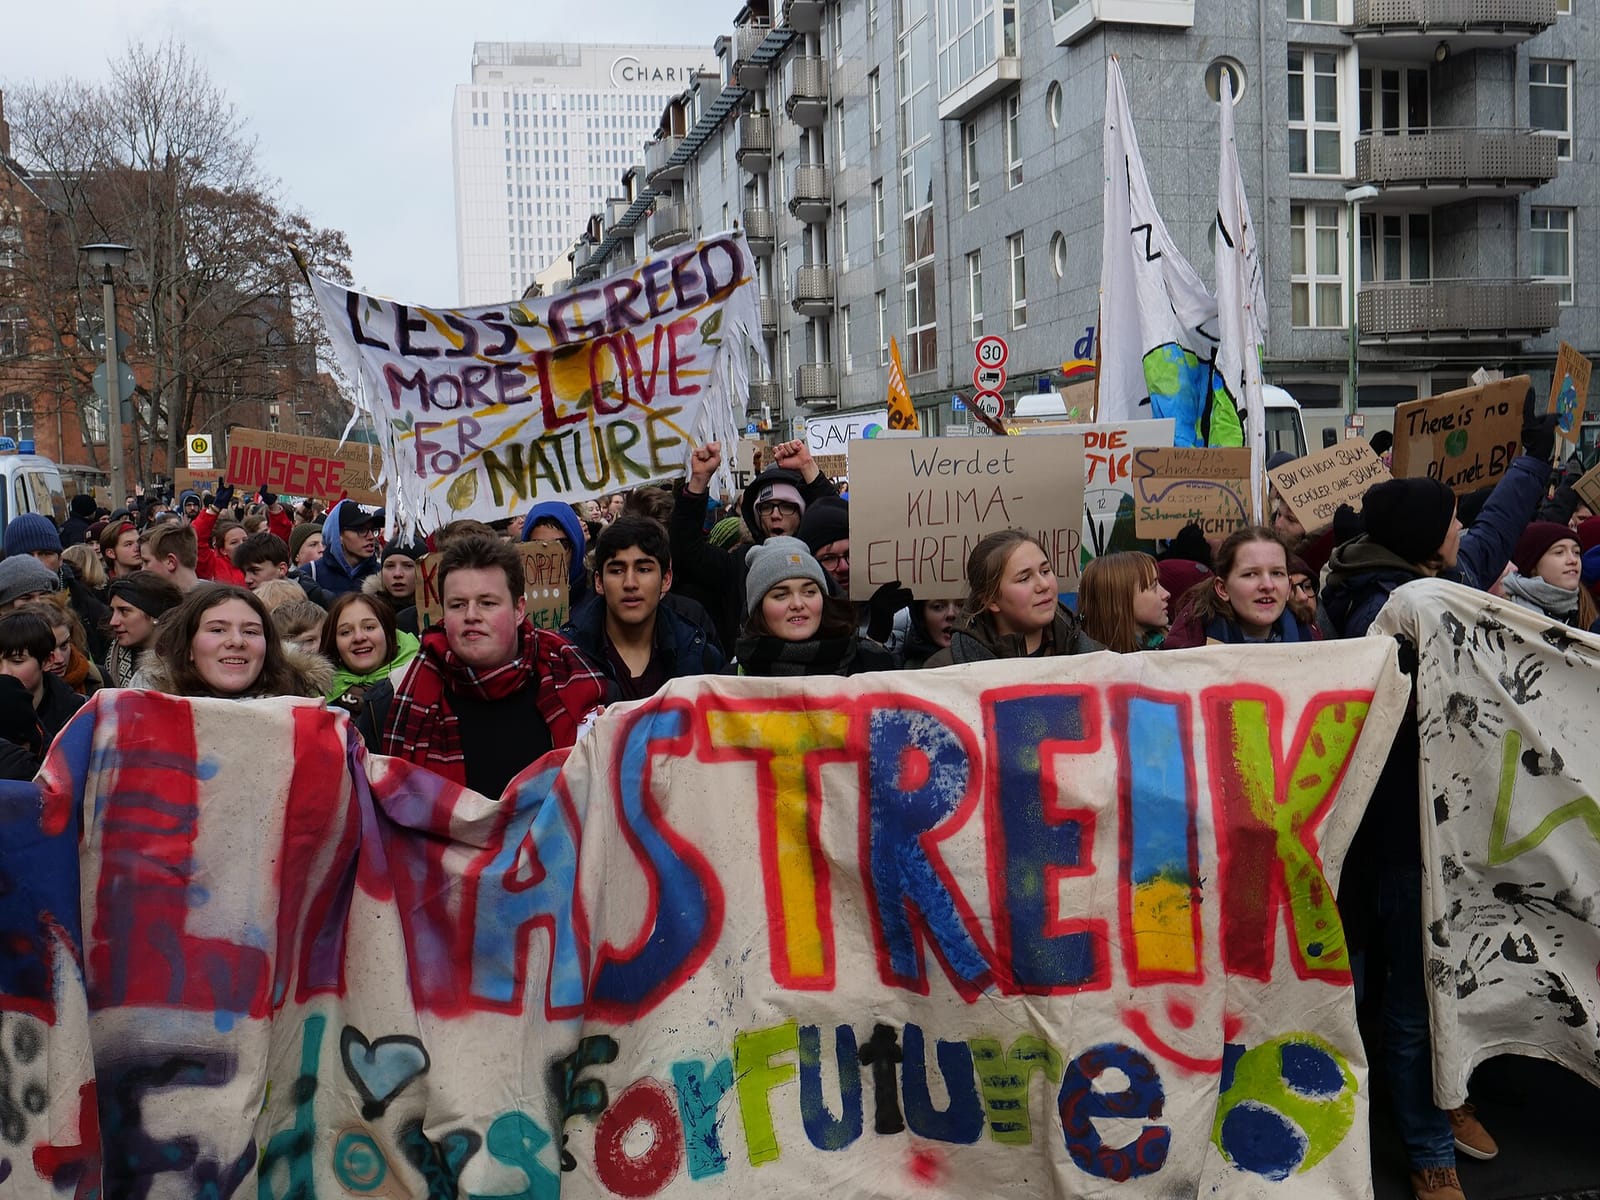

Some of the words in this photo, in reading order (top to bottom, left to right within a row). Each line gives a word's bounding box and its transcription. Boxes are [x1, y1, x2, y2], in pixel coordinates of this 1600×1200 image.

[345, 290, 519, 358] LESS
[547, 239, 745, 346] GREED
[982, 345, 1001, 361] 30
[1073, 326, 1096, 360] d
[383, 361, 533, 412] MORE
[533, 317, 702, 430] LOVE
[810, 423, 860, 450] SAVE
[1406, 408, 1455, 437] There
[1458, 405, 1474, 427] is
[1485, 402, 1509, 420] no
[413, 415, 482, 480] FOR
[482, 405, 685, 507] NATURE
[1084, 430, 1128, 449] DIE
[227, 446, 345, 497] UNSERE
[910, 447, 1016, 477] Werdet
[1085, 453, 1133, 486] TIC
[1427, 453, 1485, 487] Planet
[907, 485, 1024, 529] KLIMA-
[1140, 507, 1203, 521] Schmeckt
